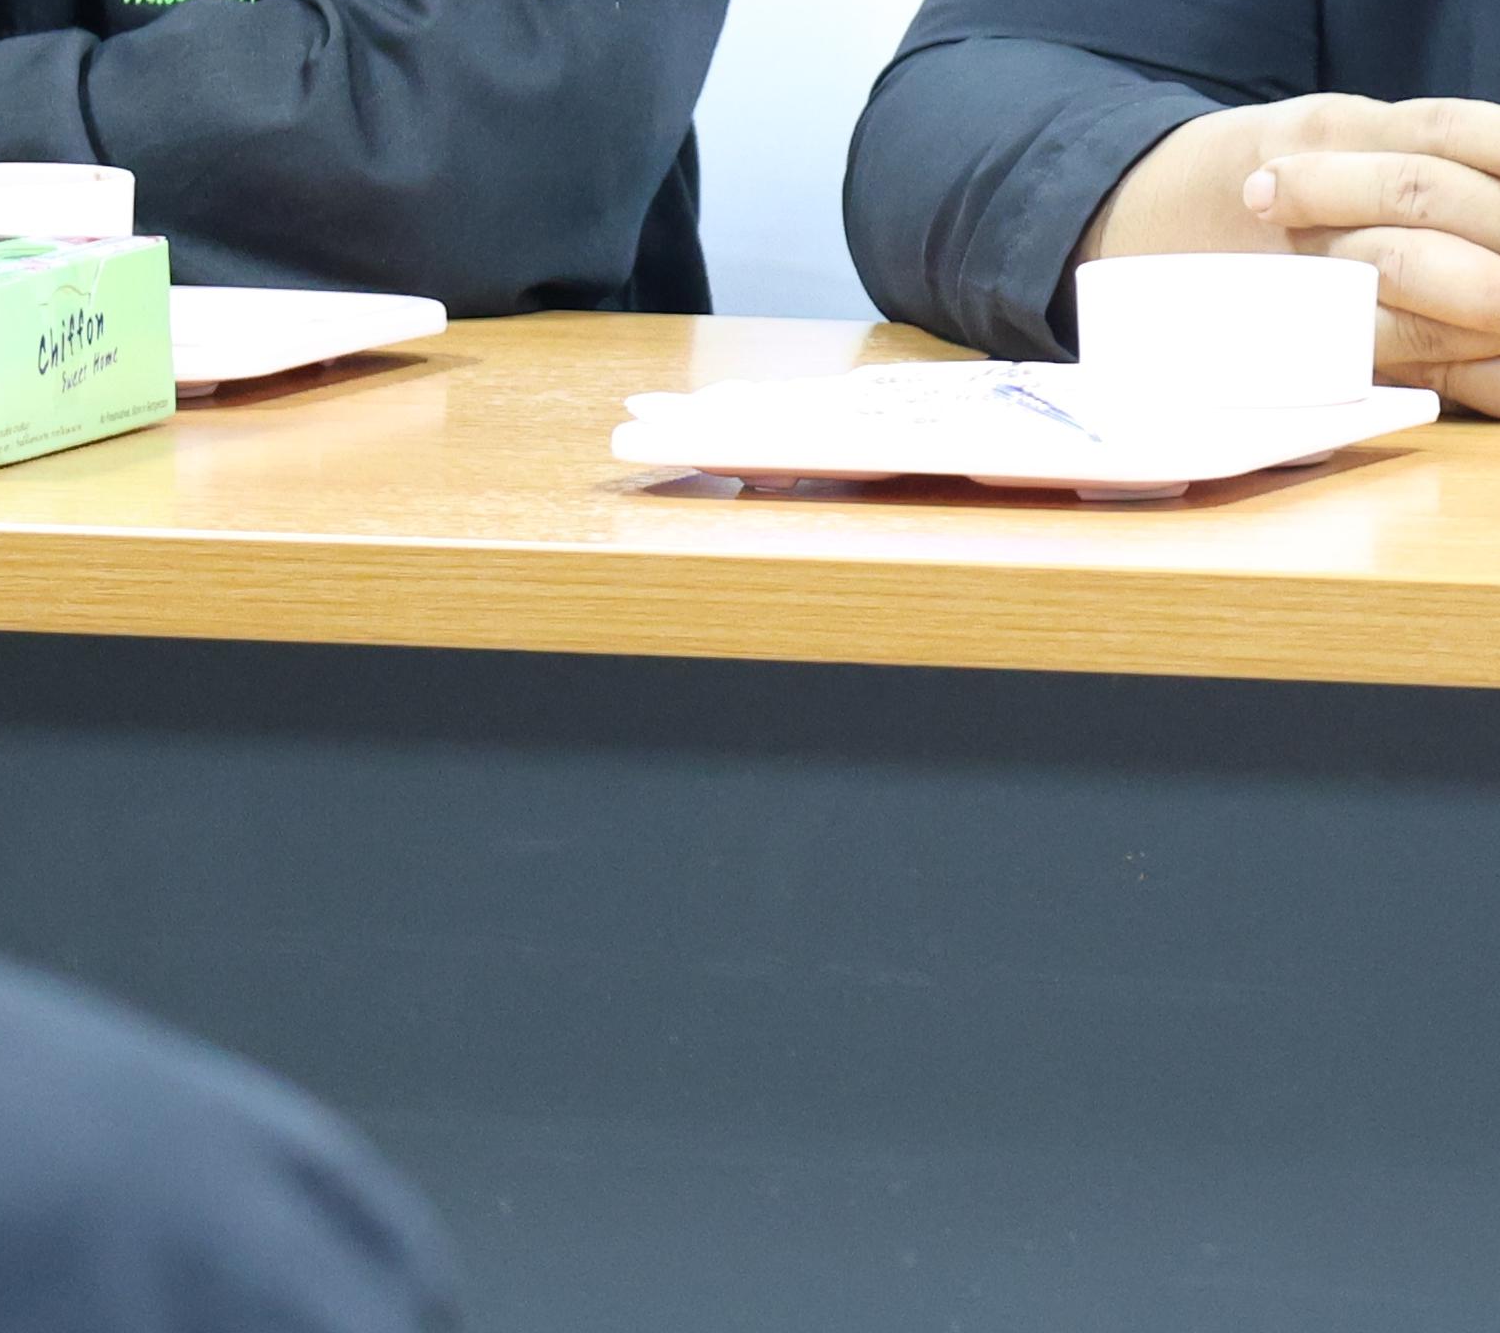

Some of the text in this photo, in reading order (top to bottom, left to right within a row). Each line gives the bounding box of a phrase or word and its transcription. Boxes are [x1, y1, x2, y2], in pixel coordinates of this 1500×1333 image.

[37, 307, 105, 376] Chiffon
[61, 346, 118, 394] Sweet Home
